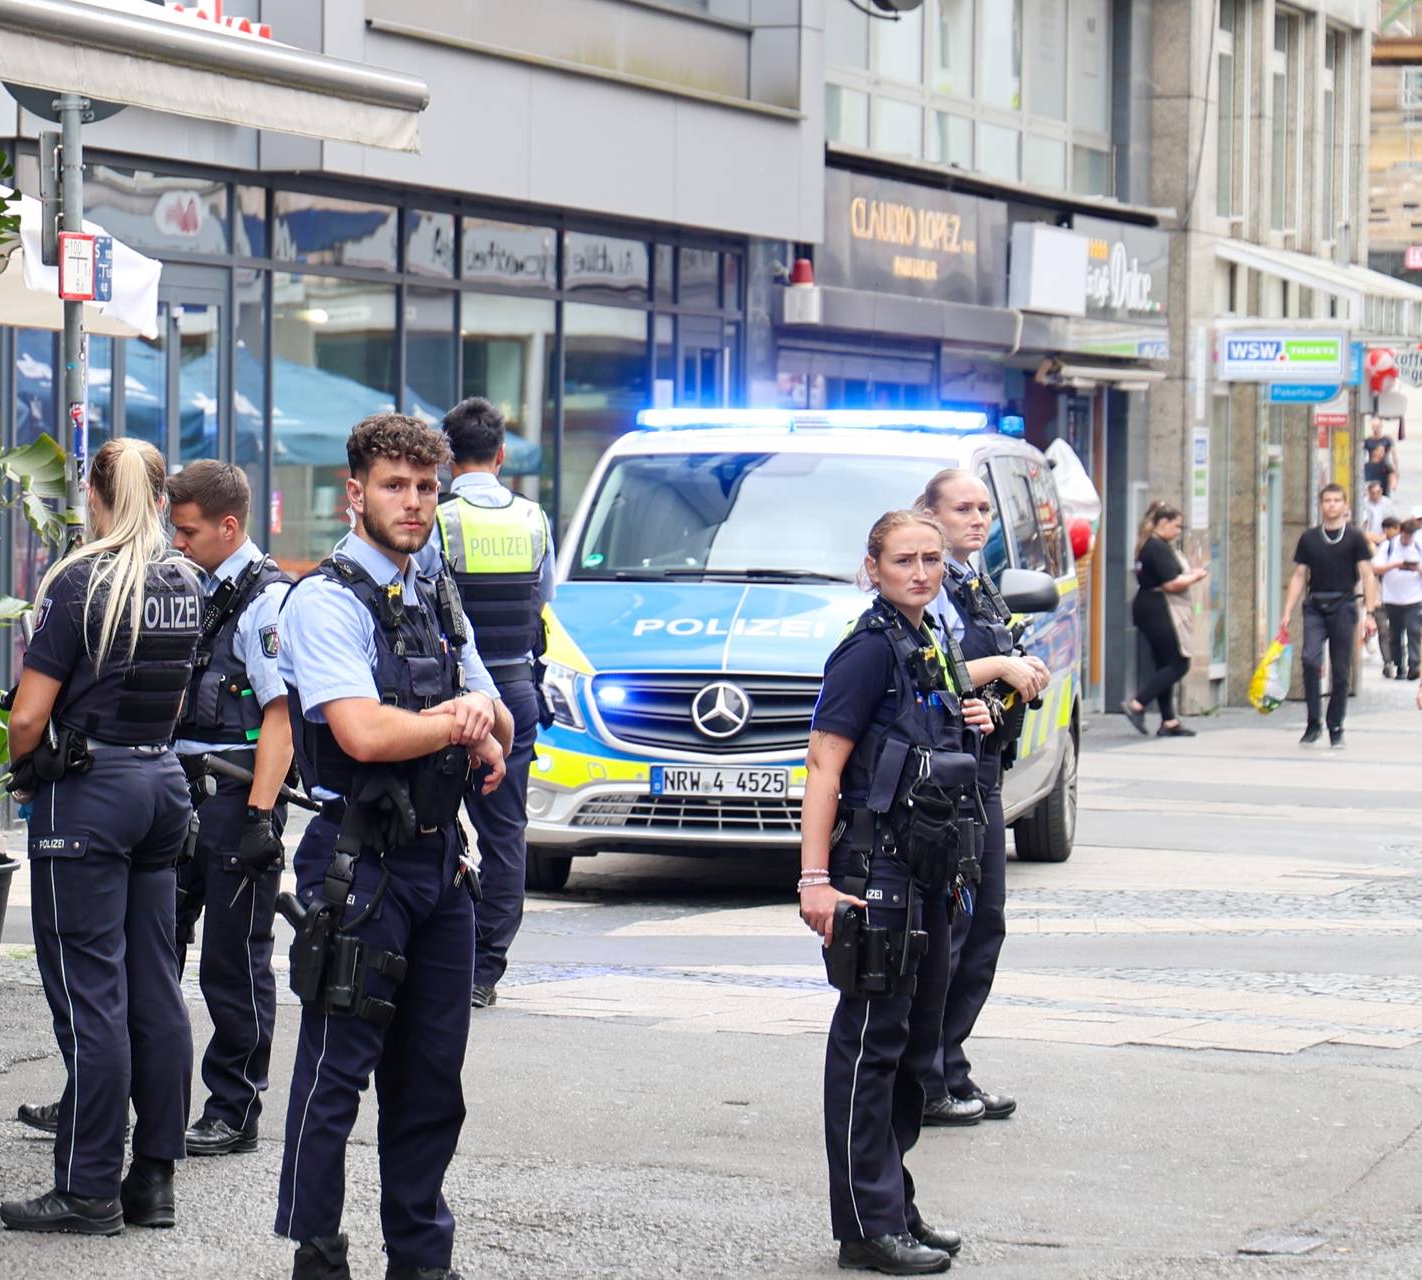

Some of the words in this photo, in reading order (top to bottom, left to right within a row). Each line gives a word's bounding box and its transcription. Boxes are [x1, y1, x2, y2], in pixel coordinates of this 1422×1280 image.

[851, 197, 915, 246] CLAUDIO
[919, 208, 961, 253] LOPEZ
[1230, 341, 1278, 359] WSW
[470, 536, 528, 557] POLIZEI
[633, 618, 826, 639] POLIZEI
[664, 771, 701, 791] NRW
[39, 839, 65, 849] POLIZEI
